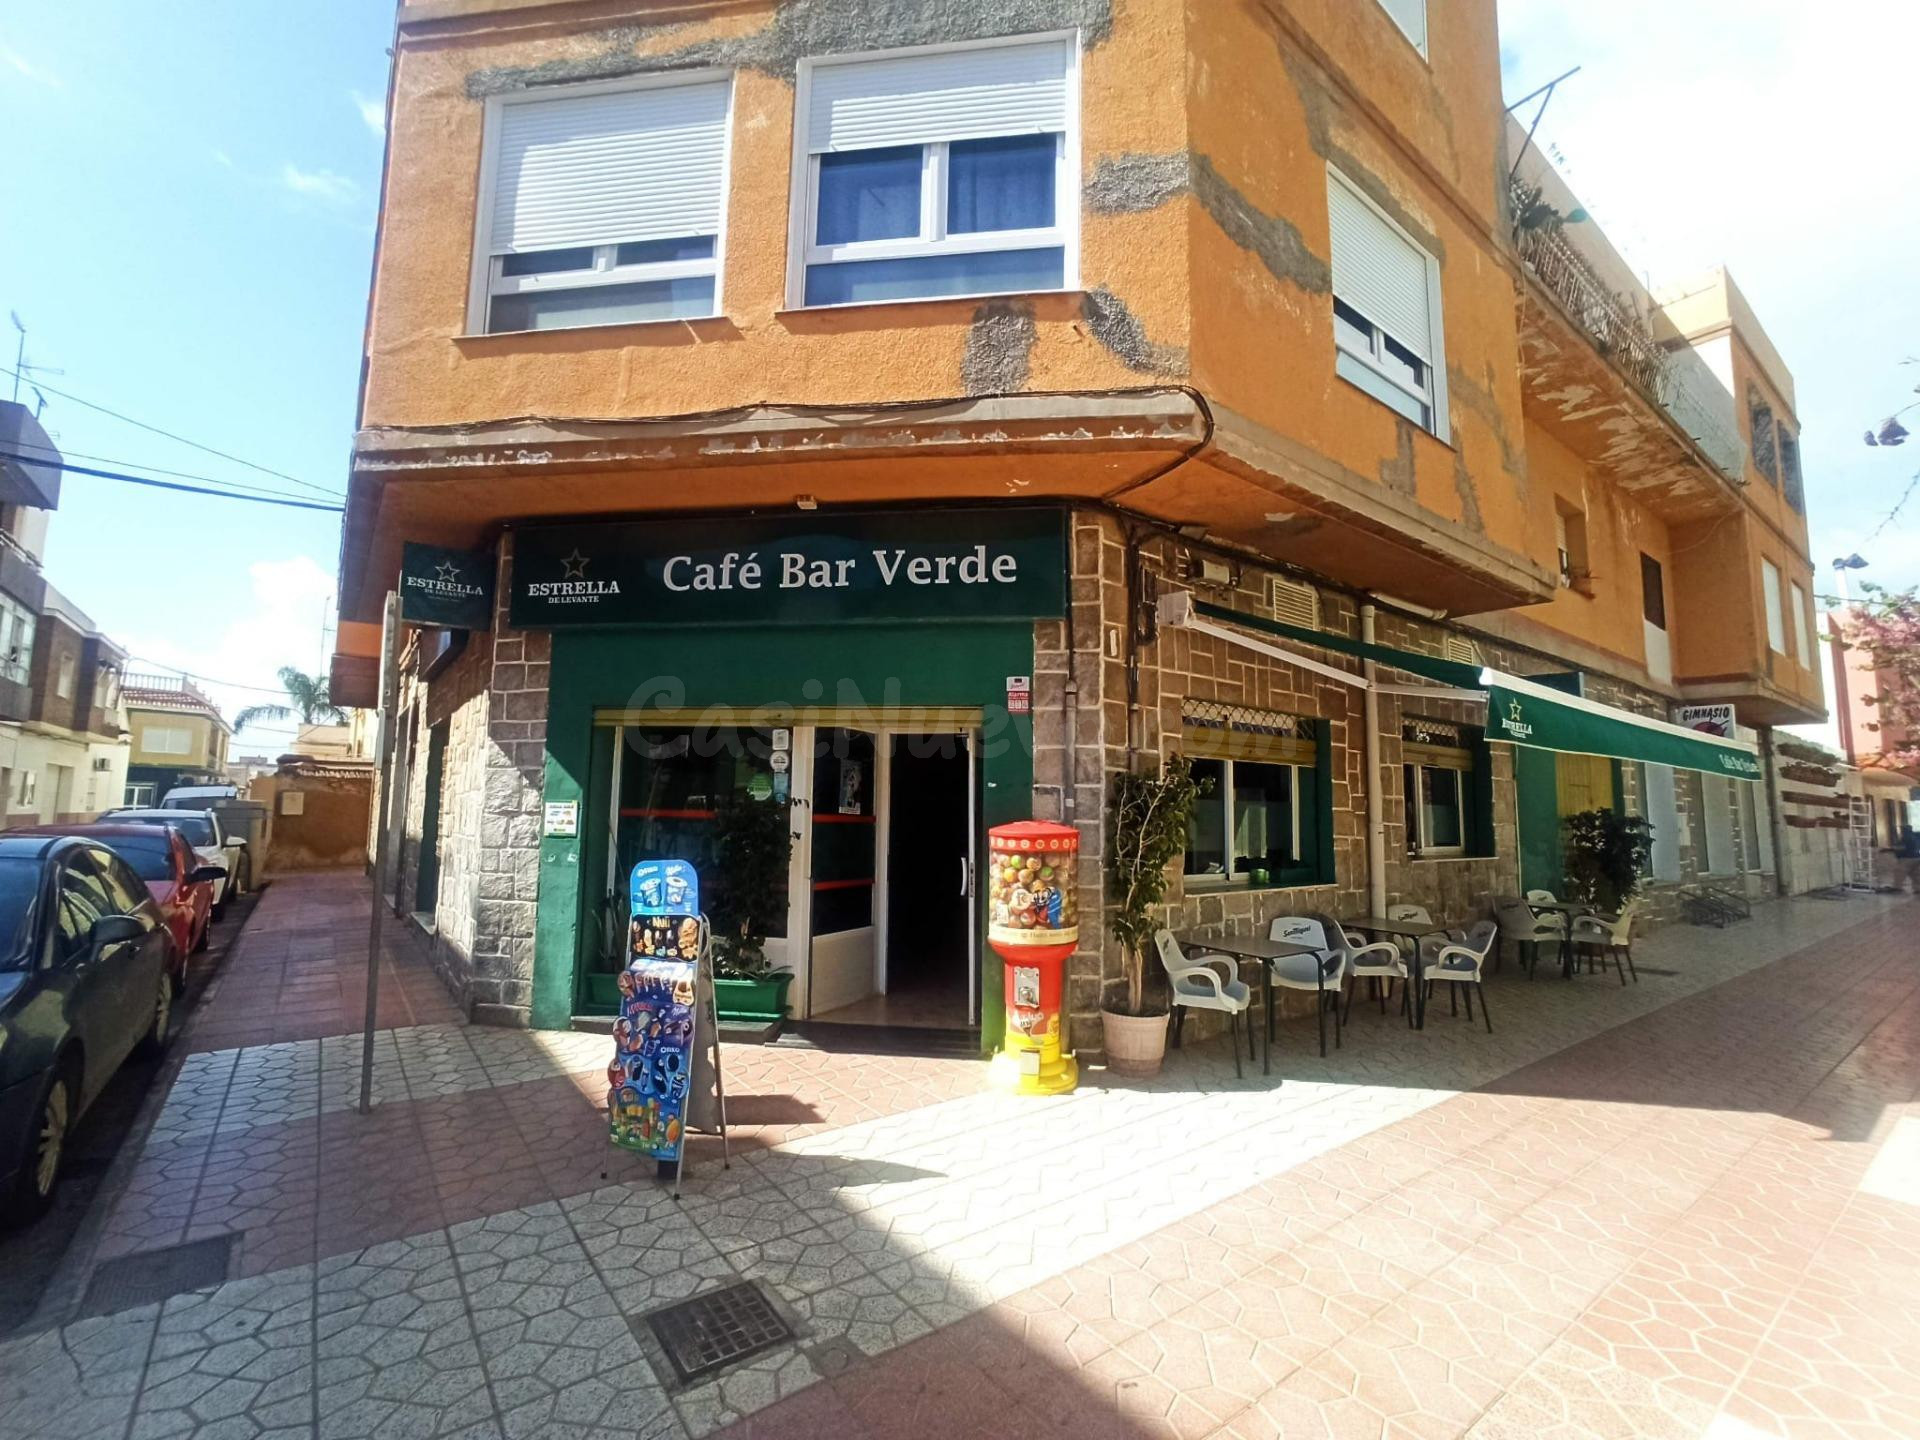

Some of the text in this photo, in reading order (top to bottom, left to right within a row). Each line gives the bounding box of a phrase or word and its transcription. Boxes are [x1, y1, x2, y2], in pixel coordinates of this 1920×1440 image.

[663, 545, 1018, 592] Café Bar Verde
[407, 576, 484, 596] ESTRELLA
[528, 580, 621, 597] ESTRELLA
[561, 596, 600, 604] LEVANTE
[1682, 706, 1730, 721] GIMNASIO
